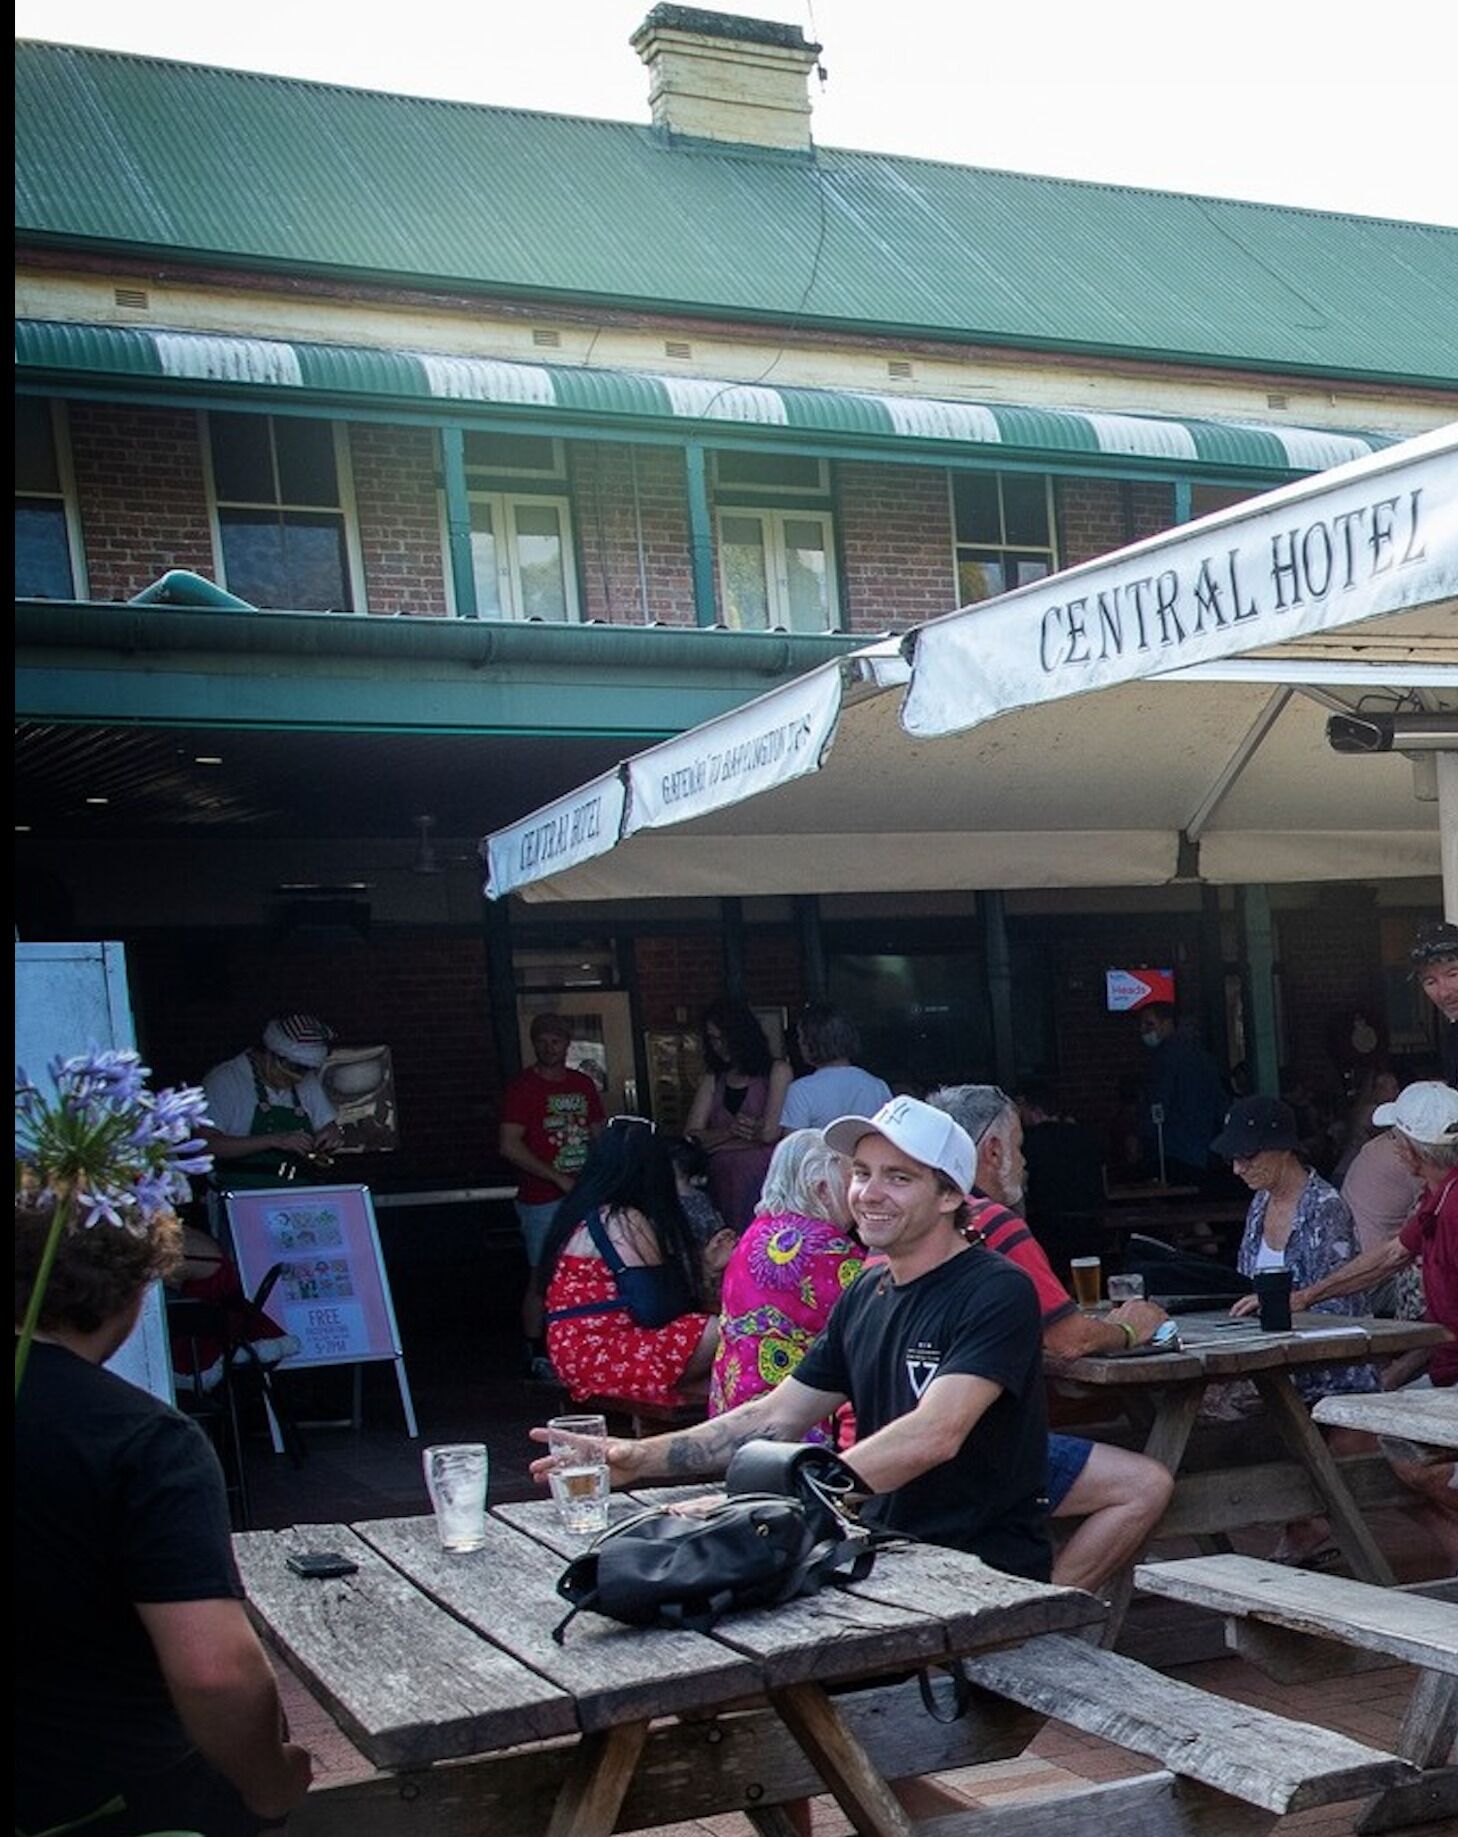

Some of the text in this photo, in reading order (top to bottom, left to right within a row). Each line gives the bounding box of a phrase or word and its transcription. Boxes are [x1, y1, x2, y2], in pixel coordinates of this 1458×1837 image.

[1039, 488, 1428, 674] CENTRAL HOTEL
[520, 796, 601, 871] CENTRAL HOTEL
[308, 1308, 341, 1327] FREE
